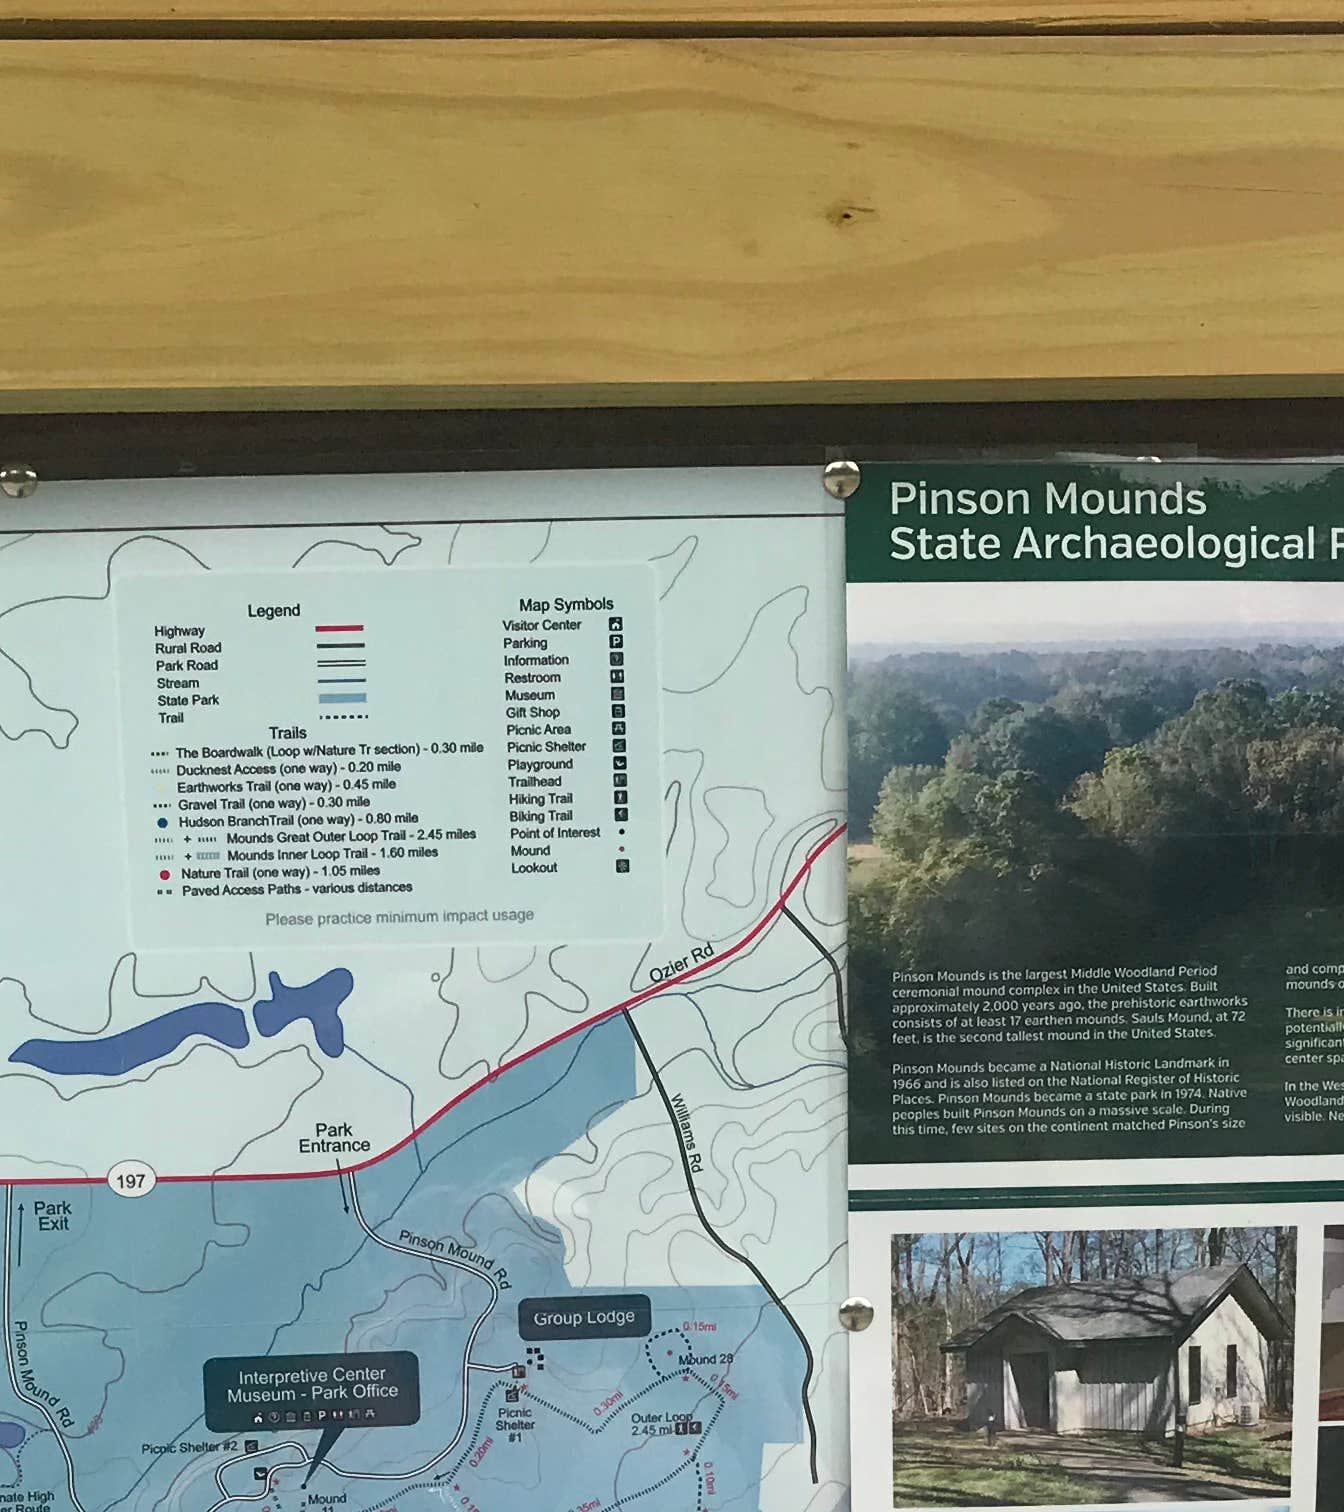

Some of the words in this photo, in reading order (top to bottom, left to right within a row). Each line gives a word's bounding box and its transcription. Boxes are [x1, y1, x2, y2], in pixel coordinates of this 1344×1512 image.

[891, 480, 1030, 515] Pinson
[1046, 481, 1207, 515] Mounds
[890, 526, 1001, 560] State
[1013, 524, 1315, 569] Archaeological
[247, 603, 300, 620] Legend
[519, 598, 550, 614] Map
[553, 596, 614, 614] Symbols
[154, 625, 205, 639] Highway
[155, 642, 187, 654] Rural
[189, 641, 222, 653] Road
[503, 637, 547, 651] Parking
[157, 694, 188, 706] State
[191, 693, 219, 706] Park
[505, 689, 555, 701] Museum
[265, 912, 314, 925] Please
[316, 911, 371, 928] practice
[375, 910, 441, 927] minimum
[442, 908, 488, 926] impact
[491, 907, 534, 924] usage
[649, 958, 689, 983] Ozier
[690, 941, 715, 963] Rd
[892, 968, 933, 982] Pinson
[937, 969, 985, 981] Mounds
[988, 969, 999, 980] is
[1001, 969, 1022, 980] the
[1025, 968, 1067, 982] largest
[1071, 967, 1111, 978] Middle
[1113, 963, 1175, 978] Woodland
[1178, 962, 1217, 976] Period
[315, 1121, 353, 1137] Park
[298, 1138, 370, 1153] Entrance
[116, 1173, 145, 1189] 197
[33, 1199, 72, 1215] Park
[38, 1215, 69, 1231] Exit
[399, 1229, 445, 1253] Pinson
[447, 1241, 496, 1271] Mound
[493, 1264, 513, 1291] Rd
[533, 1312, 582, 1327] Group
[587, 1309, 634, 1326] Lodge
[239, 1368, 327, 1387] Interpretive
[332, 1366, 386, 1382] Center
[227, 1387, 295, 1402] Museum
[311, 1384, 348, 1400] Park
[352, 1383, 398, 1398] Office
